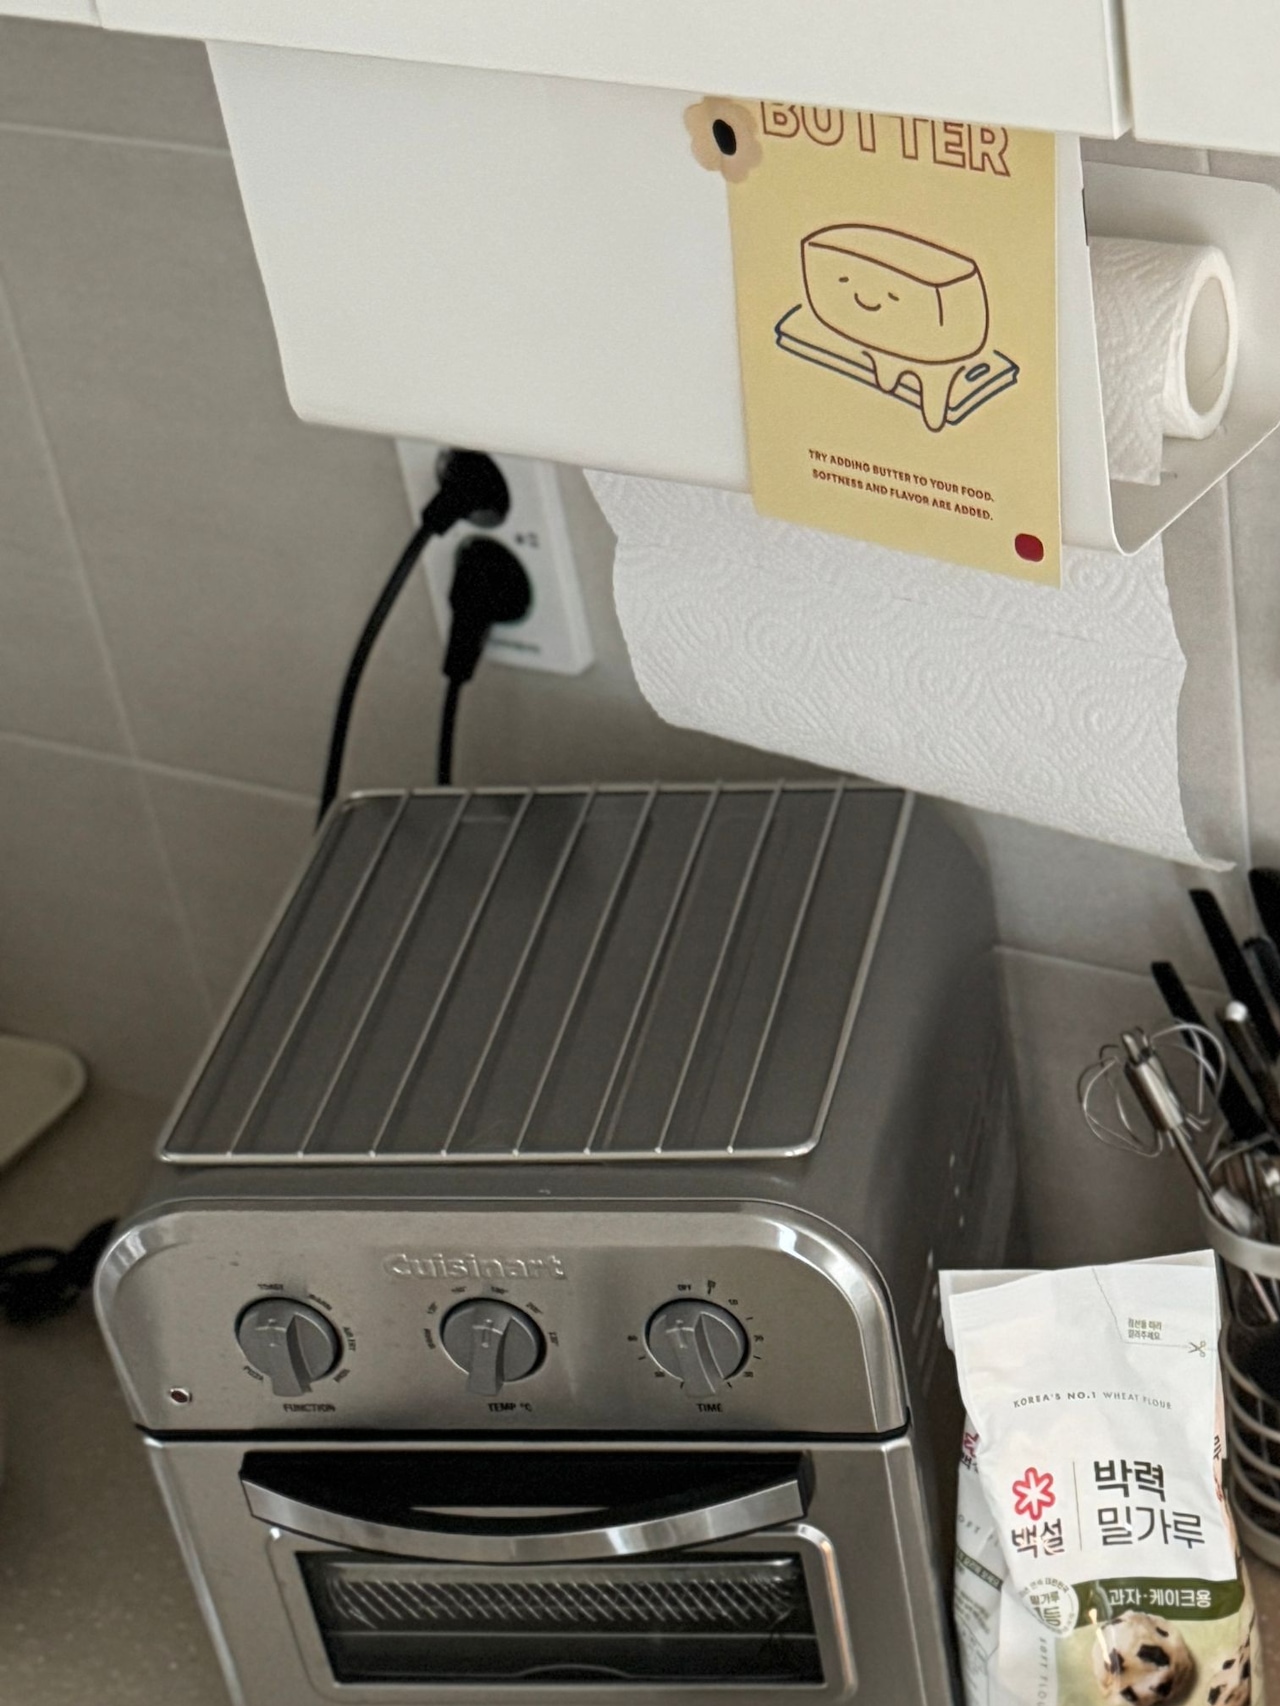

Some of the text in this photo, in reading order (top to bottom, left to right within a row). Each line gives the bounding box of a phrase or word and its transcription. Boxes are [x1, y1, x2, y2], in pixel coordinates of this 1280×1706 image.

[808, 449, 828, 462] TRY
[830, 455, 870, 473] ADDING
[872, 465, 911, 483] BUTTER
[912, 474, 928, 487] TO
[929, 478, 959, 494] YOUR
[812, 468, 994, 521] SOFTNESS AND FLAVOR ARE ADDED.
[382, 1253, 568, 1280] Cuisinart
[283, 1403, 336, 1412] FUNCTION
[488, 1403, 516, 1412] TEMP
[696, 1403, 723, 1413] TIME
[1013, 1391, 1172, 1410] KOREA'S NO.1 WHEAT FLOUR
[1094, 1459, 1166, 1503] 박력
[1011, 1518, 1065, 1559] 백설
[1098, 1506, 1206, 1549] 밀가루
[1030, 1591, 1060, 1605] 밀가루
[1109, 1588, 1212, 1608] 과자·케이크용
